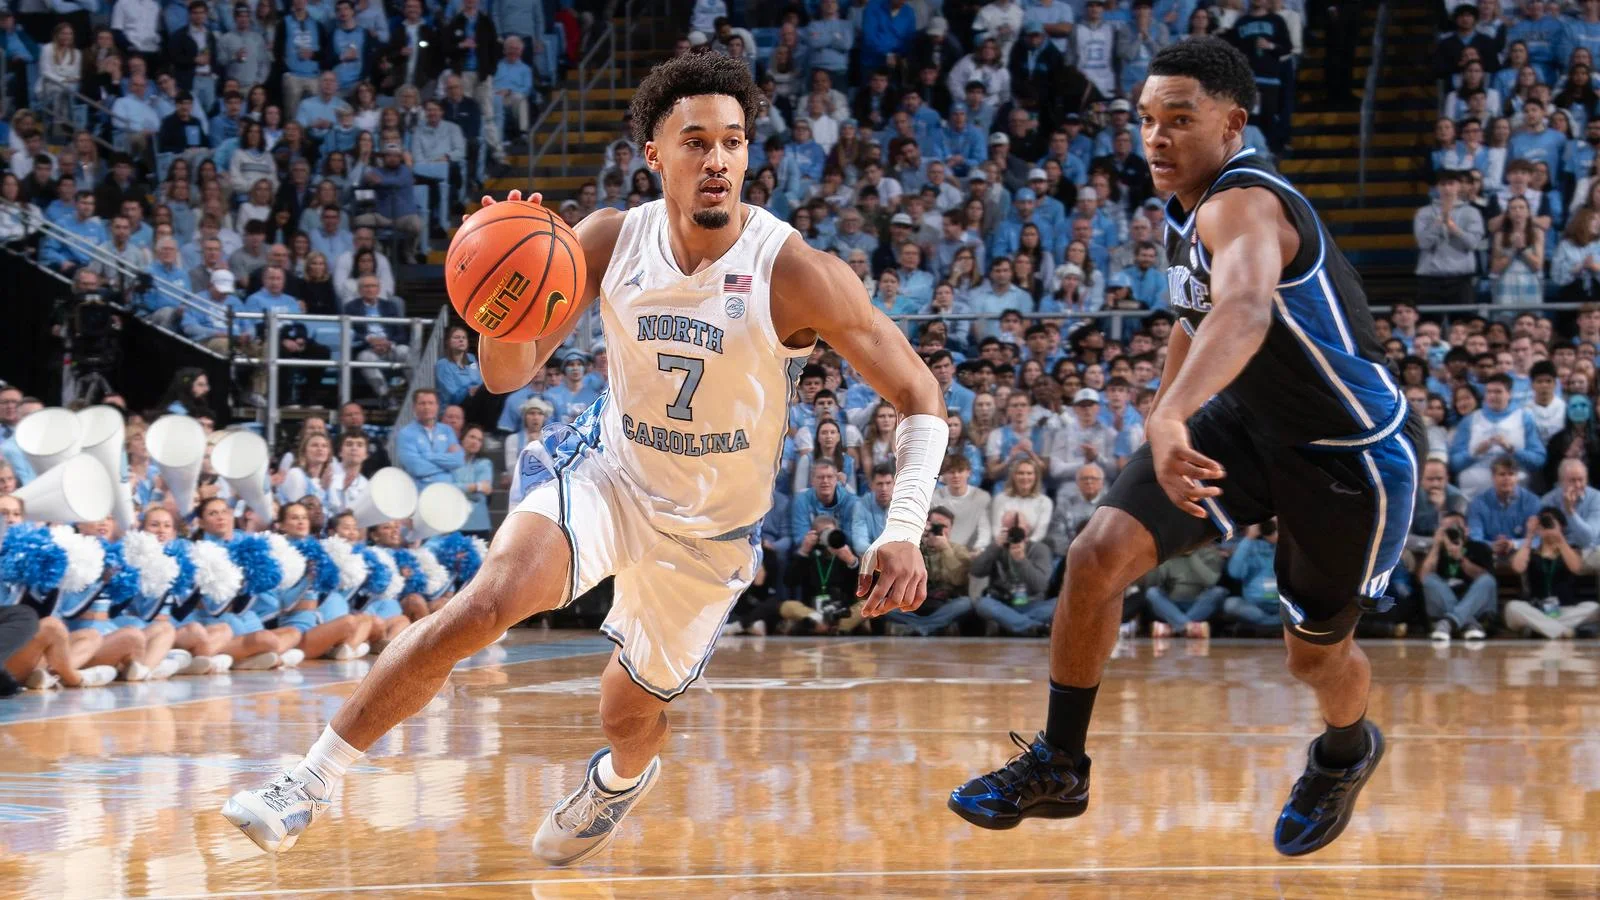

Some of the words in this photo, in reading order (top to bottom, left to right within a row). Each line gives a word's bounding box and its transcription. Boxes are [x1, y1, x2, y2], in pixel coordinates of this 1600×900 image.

[477, 271, 531, 331] ELITE
[637, 314, 725, 354] NORTH
[657, 352, 705, 421] 7
[622, 413, 750, 457] CAROLINA
